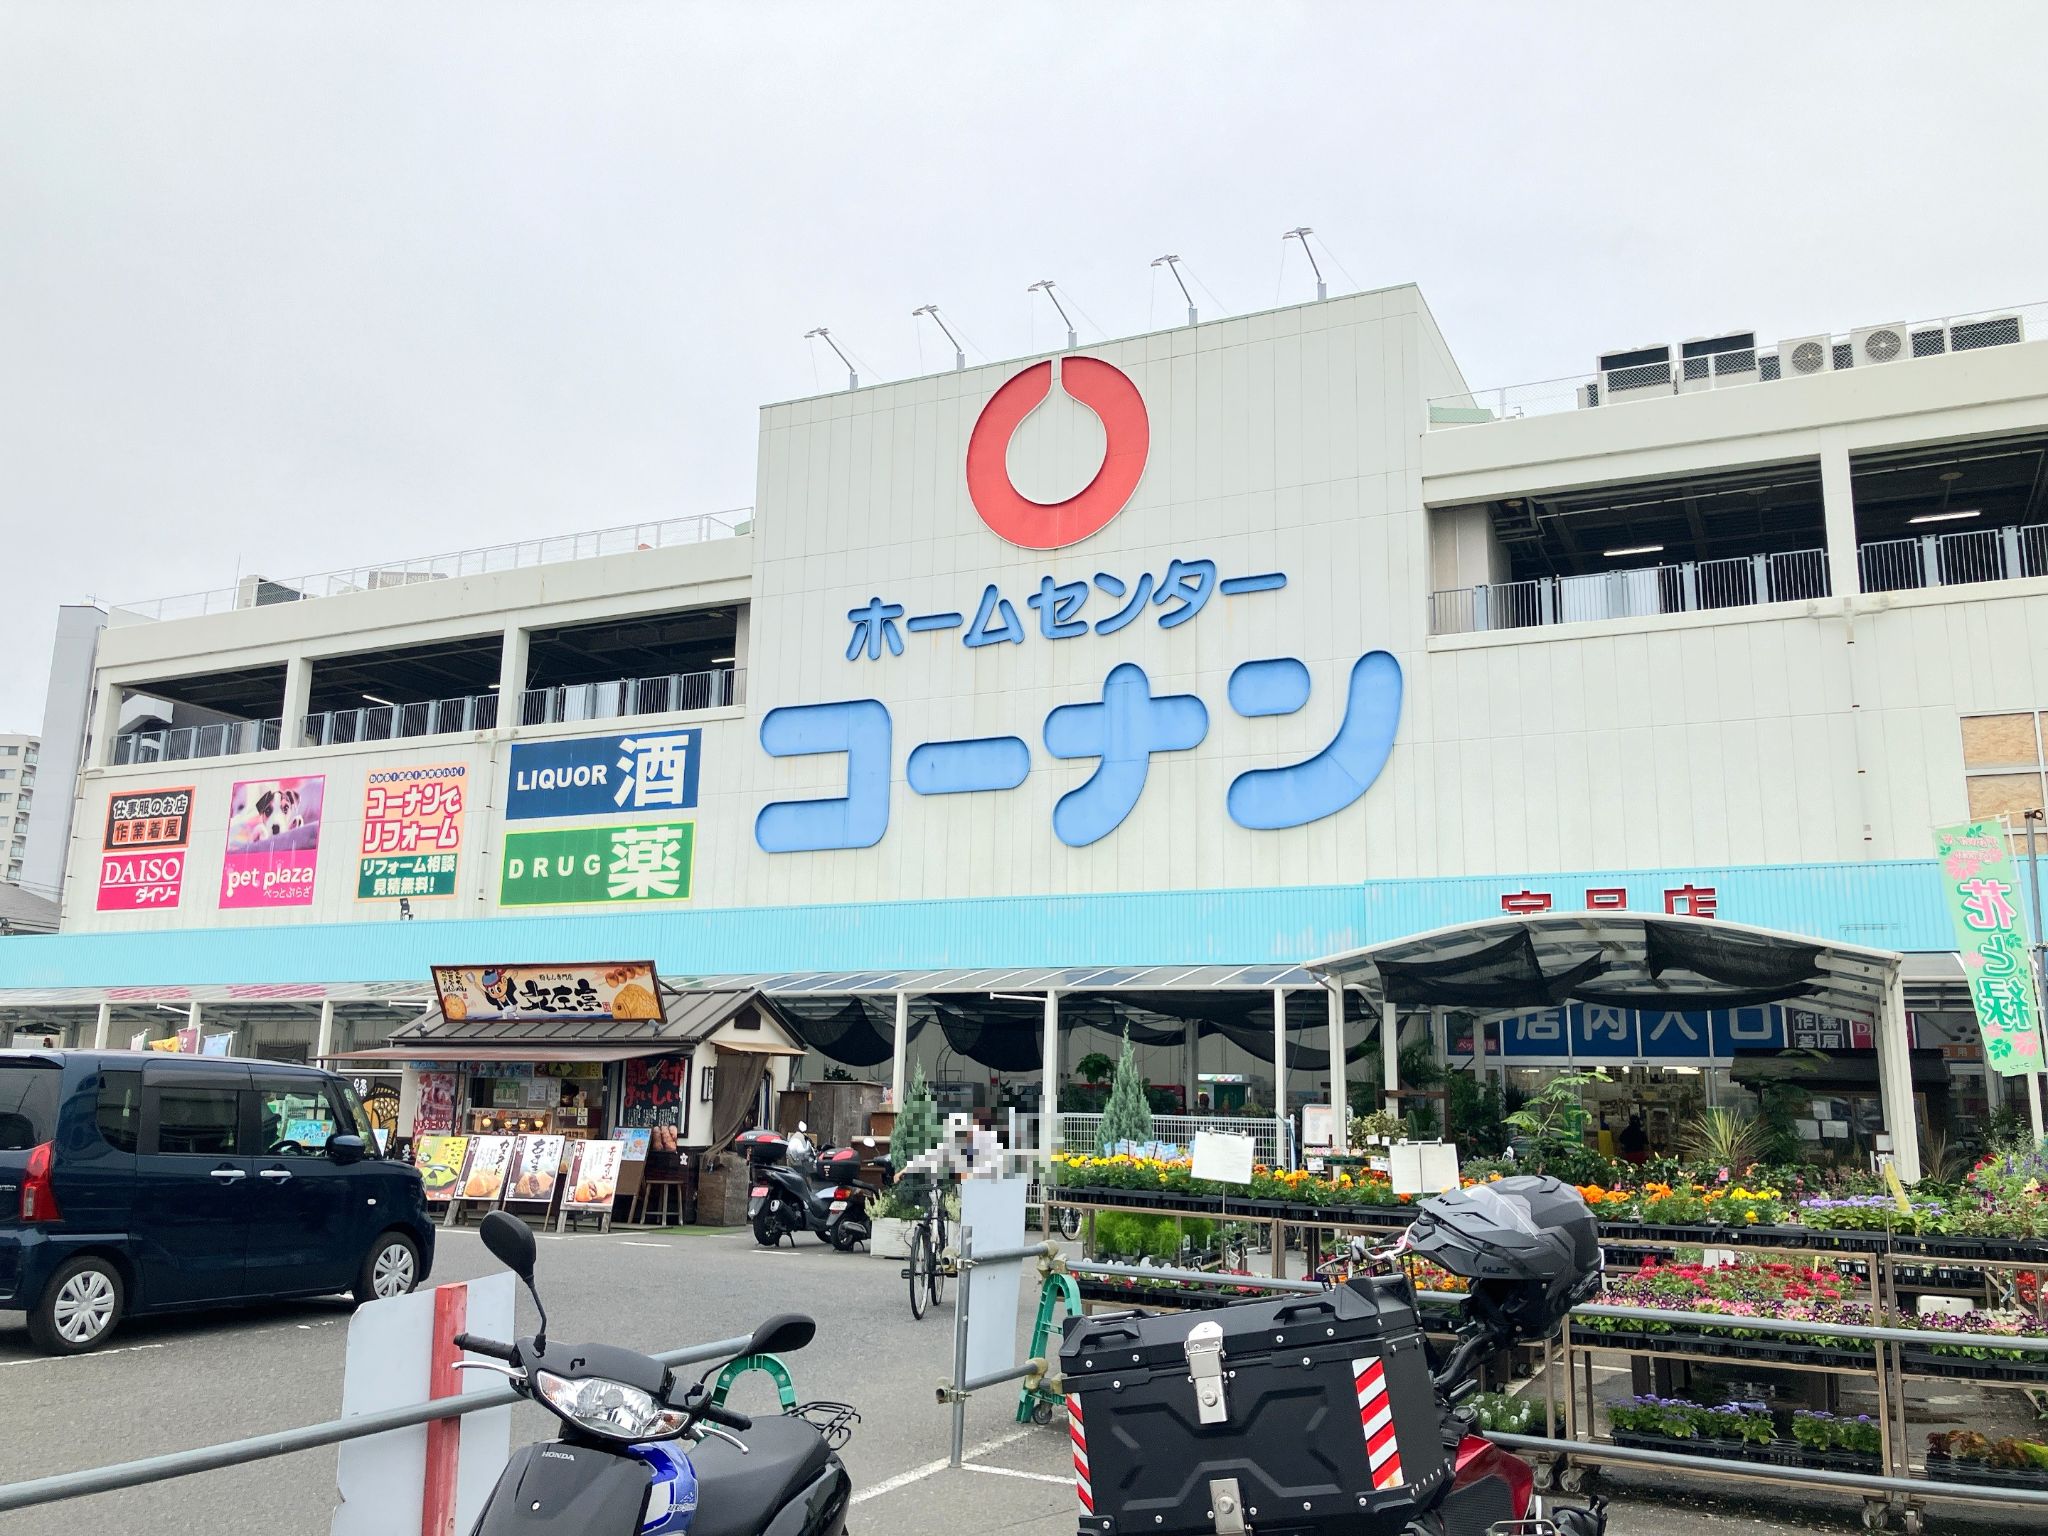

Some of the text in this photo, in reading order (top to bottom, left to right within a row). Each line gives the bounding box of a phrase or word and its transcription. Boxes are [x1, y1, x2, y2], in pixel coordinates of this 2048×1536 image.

[846, 559, 1288, 661] ホームセンター
[755, 650, 1403, 853] コーナン
[516, 734, 690, 808] LIQUOR 酒
[113, 793, 188, 820] 仕事服のお店
[366, 782, 462, 819] コーナンで
[115, 818, 179, 842] 作業着屋
[361, 818, 460, 854] リフォーム
[103, 857, 180, 884] DAISO
[226, 863, 314, 897] pet plaza
[363, 854, 456, 876] リフォーム相談
[508, 826, 683, 899] DRUG 薬
[135, 886, 177, 902] ダイソー
[1516, 1003, 1772, 1040] 店内入口
[541, 1451, 575, 1461] HONDA
